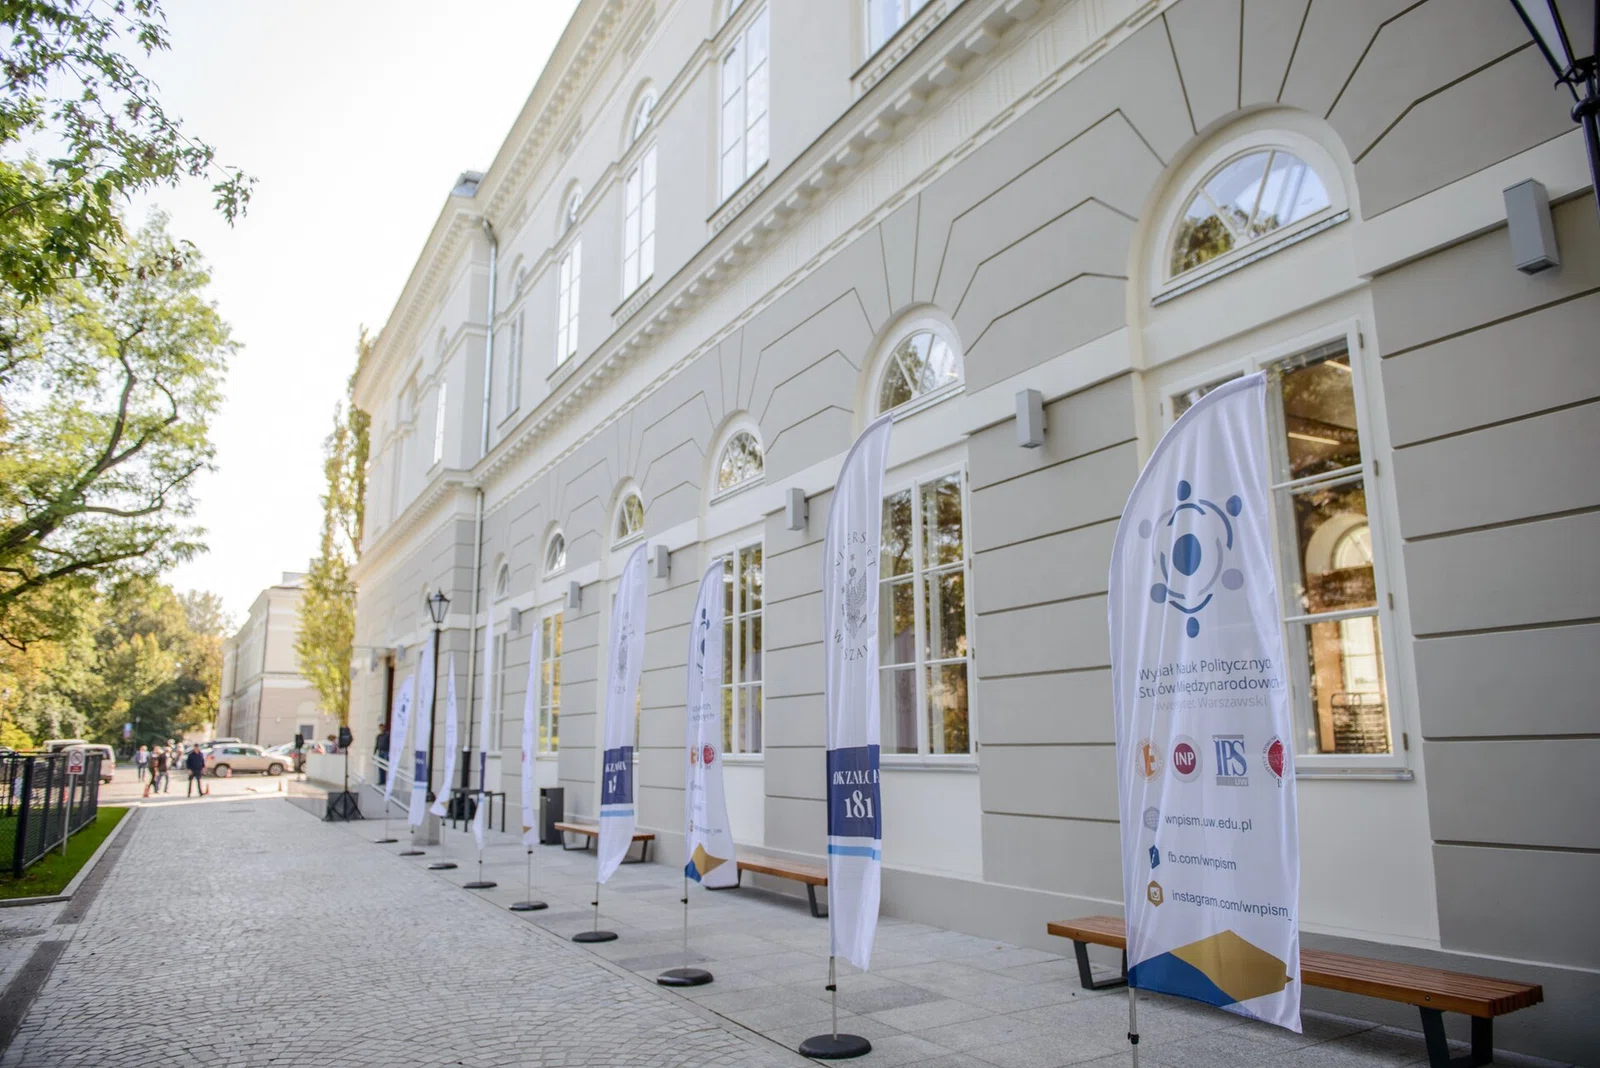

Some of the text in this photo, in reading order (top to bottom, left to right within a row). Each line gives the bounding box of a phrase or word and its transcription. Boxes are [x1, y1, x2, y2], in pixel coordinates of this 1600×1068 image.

[1176, 660, 1198, 676] Nauk
[1198, 695, 1268, 709] Warszawski
[1175, 752, 1195, 766] INP
[1213, 740, 1248, 777] IPS
[1235, 778, 1249, 786] UW
[1165, 813, 1252, 833] wnpism.uw.edu.pl
[1168, 851, 1237, 870] fb.com/wnpism
